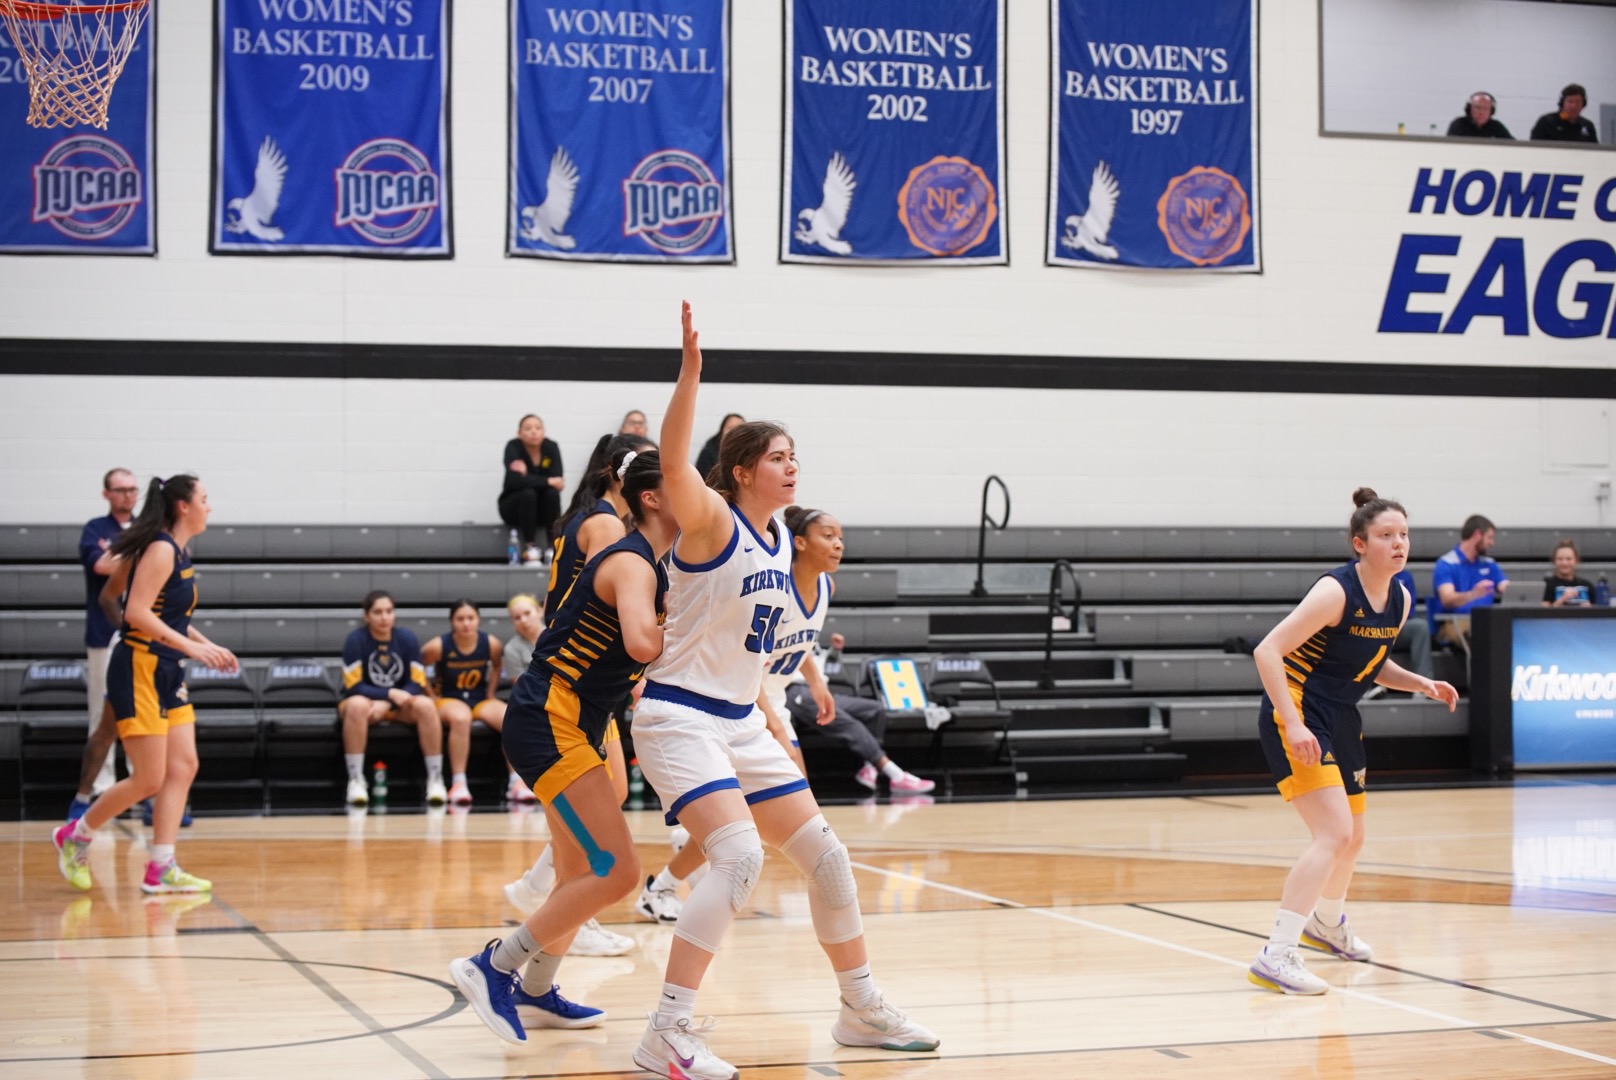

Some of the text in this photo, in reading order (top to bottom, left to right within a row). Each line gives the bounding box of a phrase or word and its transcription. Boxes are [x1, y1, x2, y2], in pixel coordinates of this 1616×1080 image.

[259, 0, 412, 28] WOMEN'S
[546, 8, 694, 40] WOMEN'S
[232, 28, 434, 61] BASKETBALL
[525, 38, 716, 75] BASKETBALL
[823, 25, 972, 60] WOMEN'S
[1087, 41, 1228, 74] WOMEN'S
[299, 63, 370, 92] 2009
[588, 76, 653, 105] 2007
[800, 56, 992, 91] BASKETBALL
[1064, 70, 1245, 106] BASKETBALL
[867, 94, 928, 123] 2002
[1131, 108, 1184, 136] 1997
[36, 168, 139, 219] NJCAA
[338, 171, 437, 222] NJCAA
[626, 182, 721, 231] NJCAA
[1408, 167, 1584, 220] HOME
[1377, 232, 1616, 340] EAG
[455, 668, 482, 691] 10
[1352, 644, 1388, 683] 1
